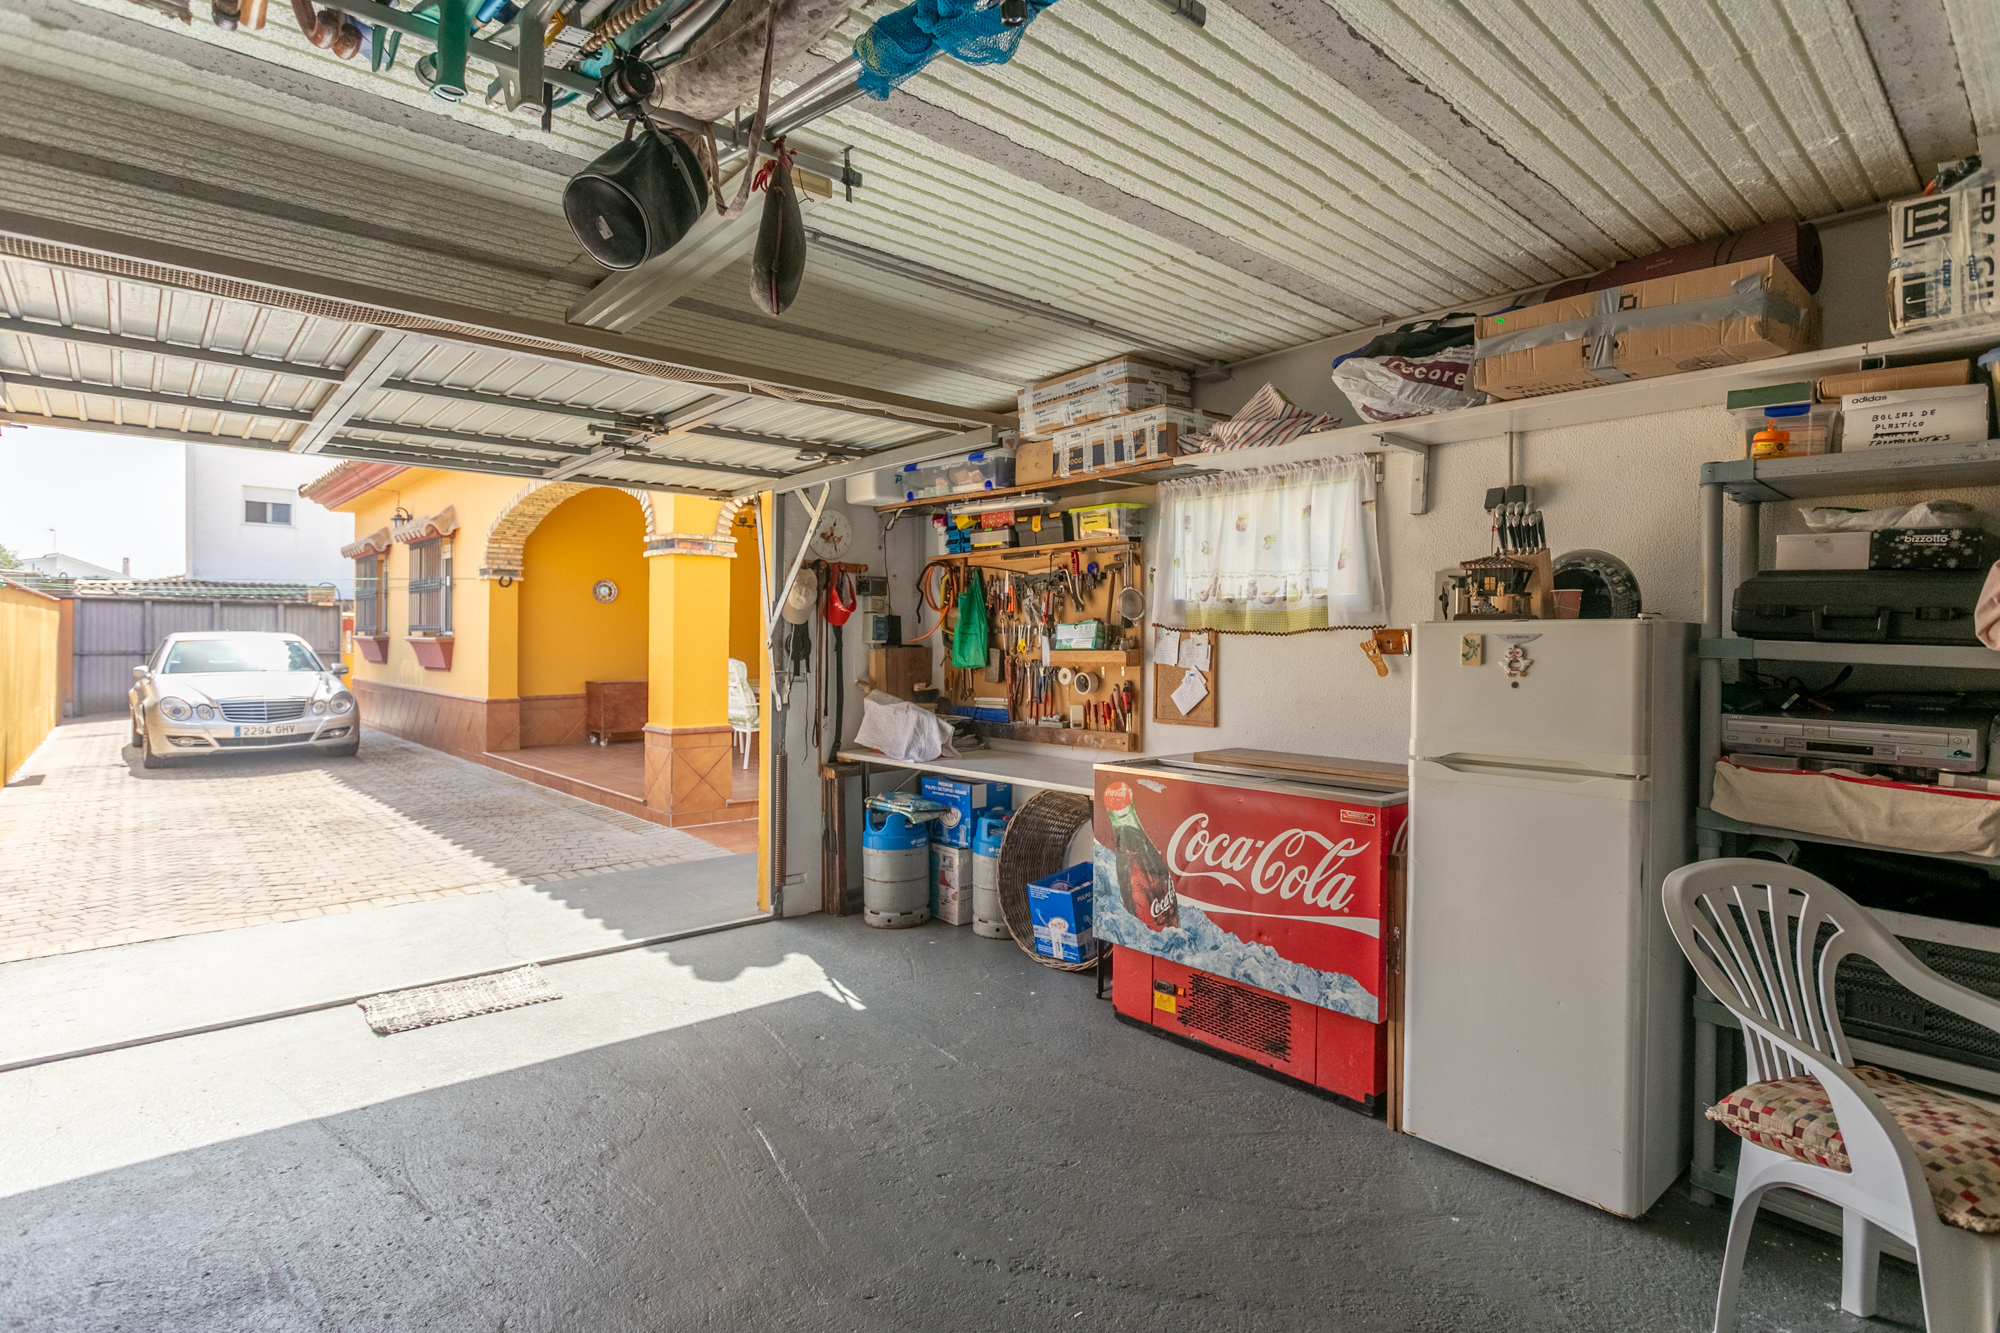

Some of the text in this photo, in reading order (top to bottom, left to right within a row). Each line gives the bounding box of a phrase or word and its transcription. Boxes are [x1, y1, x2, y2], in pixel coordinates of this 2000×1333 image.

[1941, 258, 1952, 287] tyco
[1851, 394, 1888, 404] adidas
[1871, 409, 1937, 422] BOLSAS DE
[1904, 534, 1948, 543] bizzotto
[243, 724, 296, 736] 2294 GHV
[1166, 812, 1371, 912] Coca-Cola
